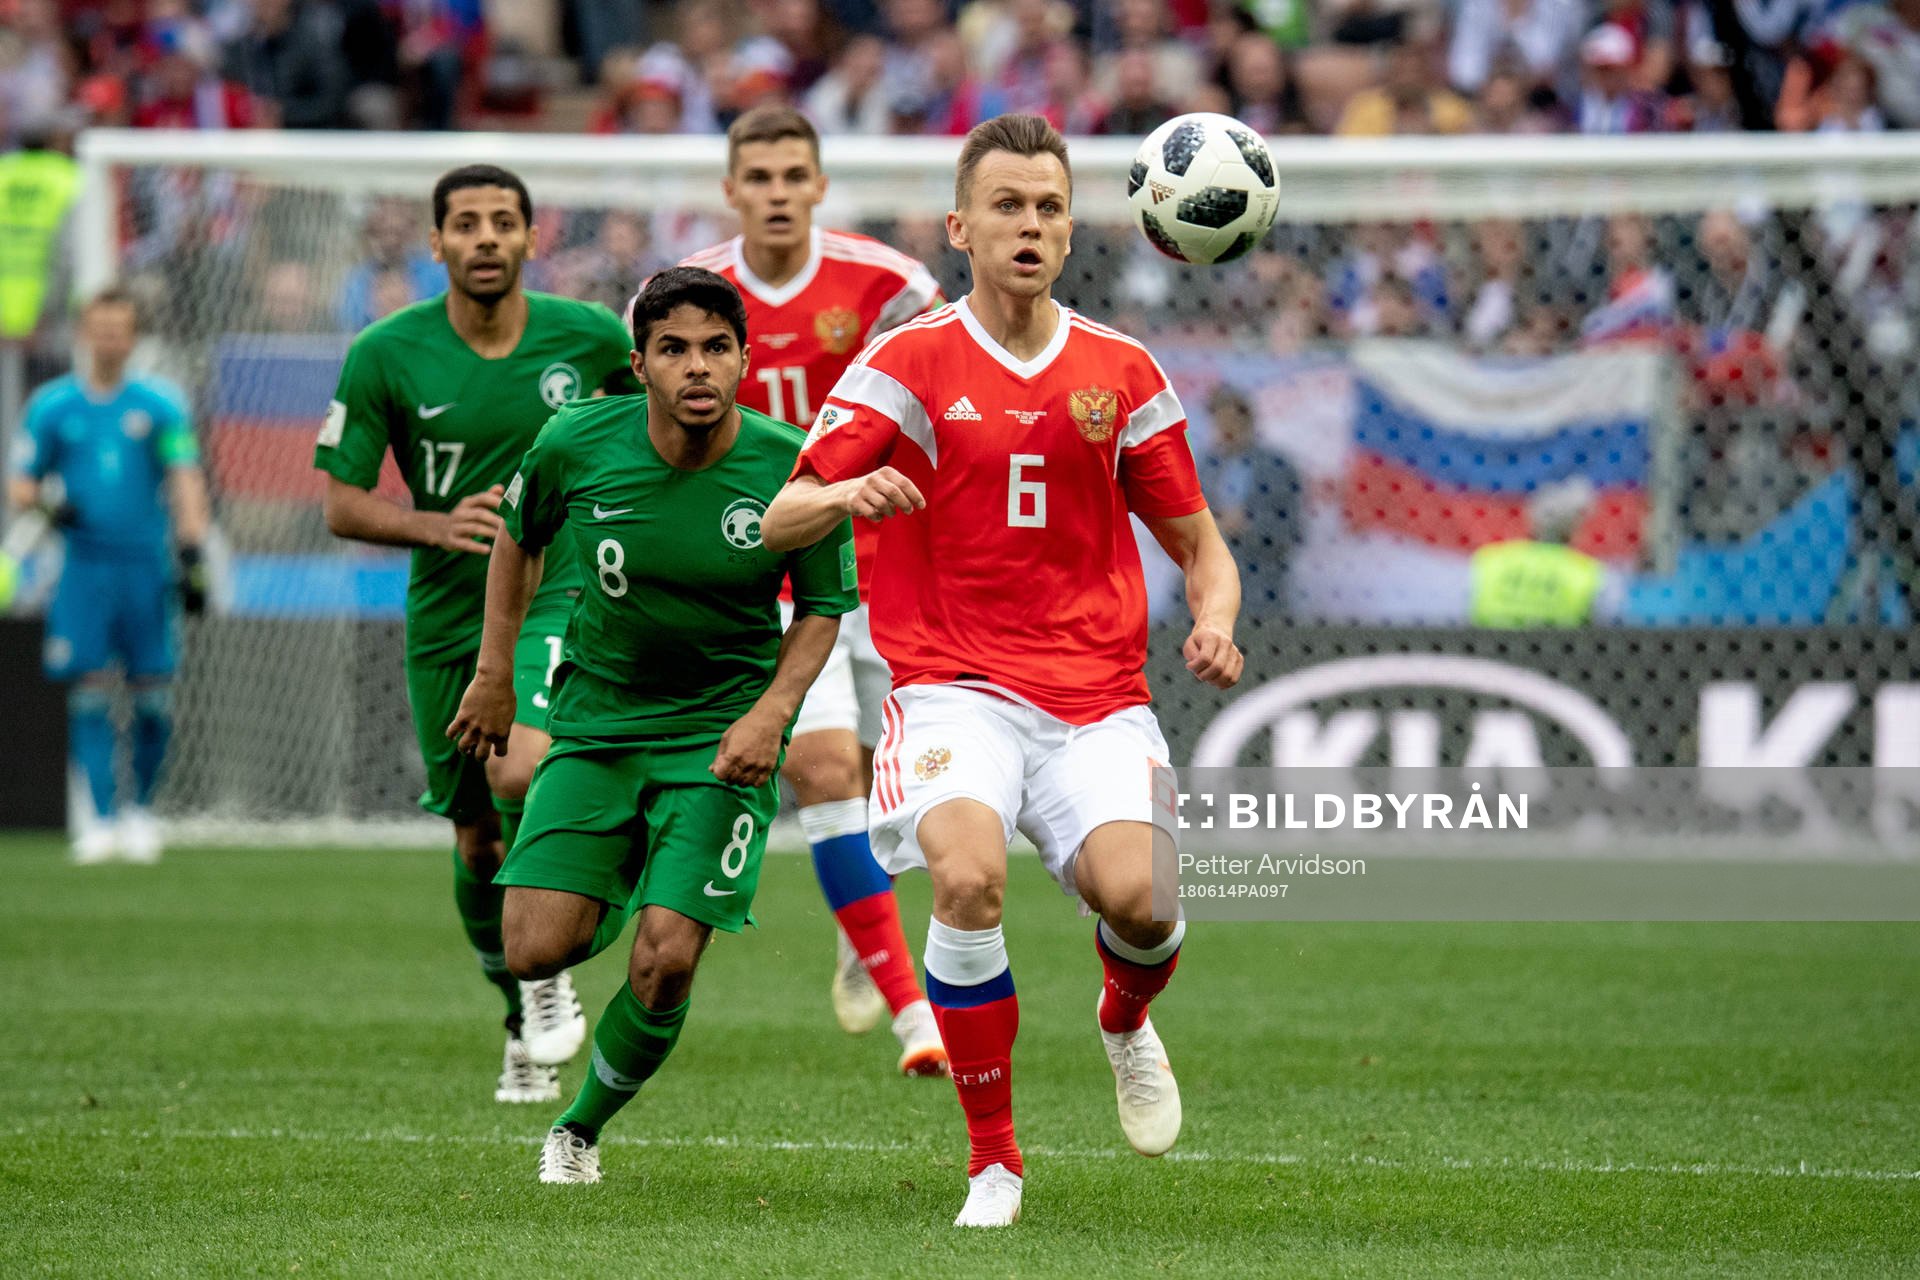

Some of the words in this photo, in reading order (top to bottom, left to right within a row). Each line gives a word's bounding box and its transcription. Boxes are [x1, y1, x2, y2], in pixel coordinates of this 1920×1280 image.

[757, 366, 817, 425] 11
[944, 412, 982, 421] adidas
[420, 438, 466, 498] 17
[1007, 453, 1047, 529] 6
[597, 538, 629, 598] 8
[1268, 709, 1549, 806] KIA
[720, 813, 754, 879] 8
